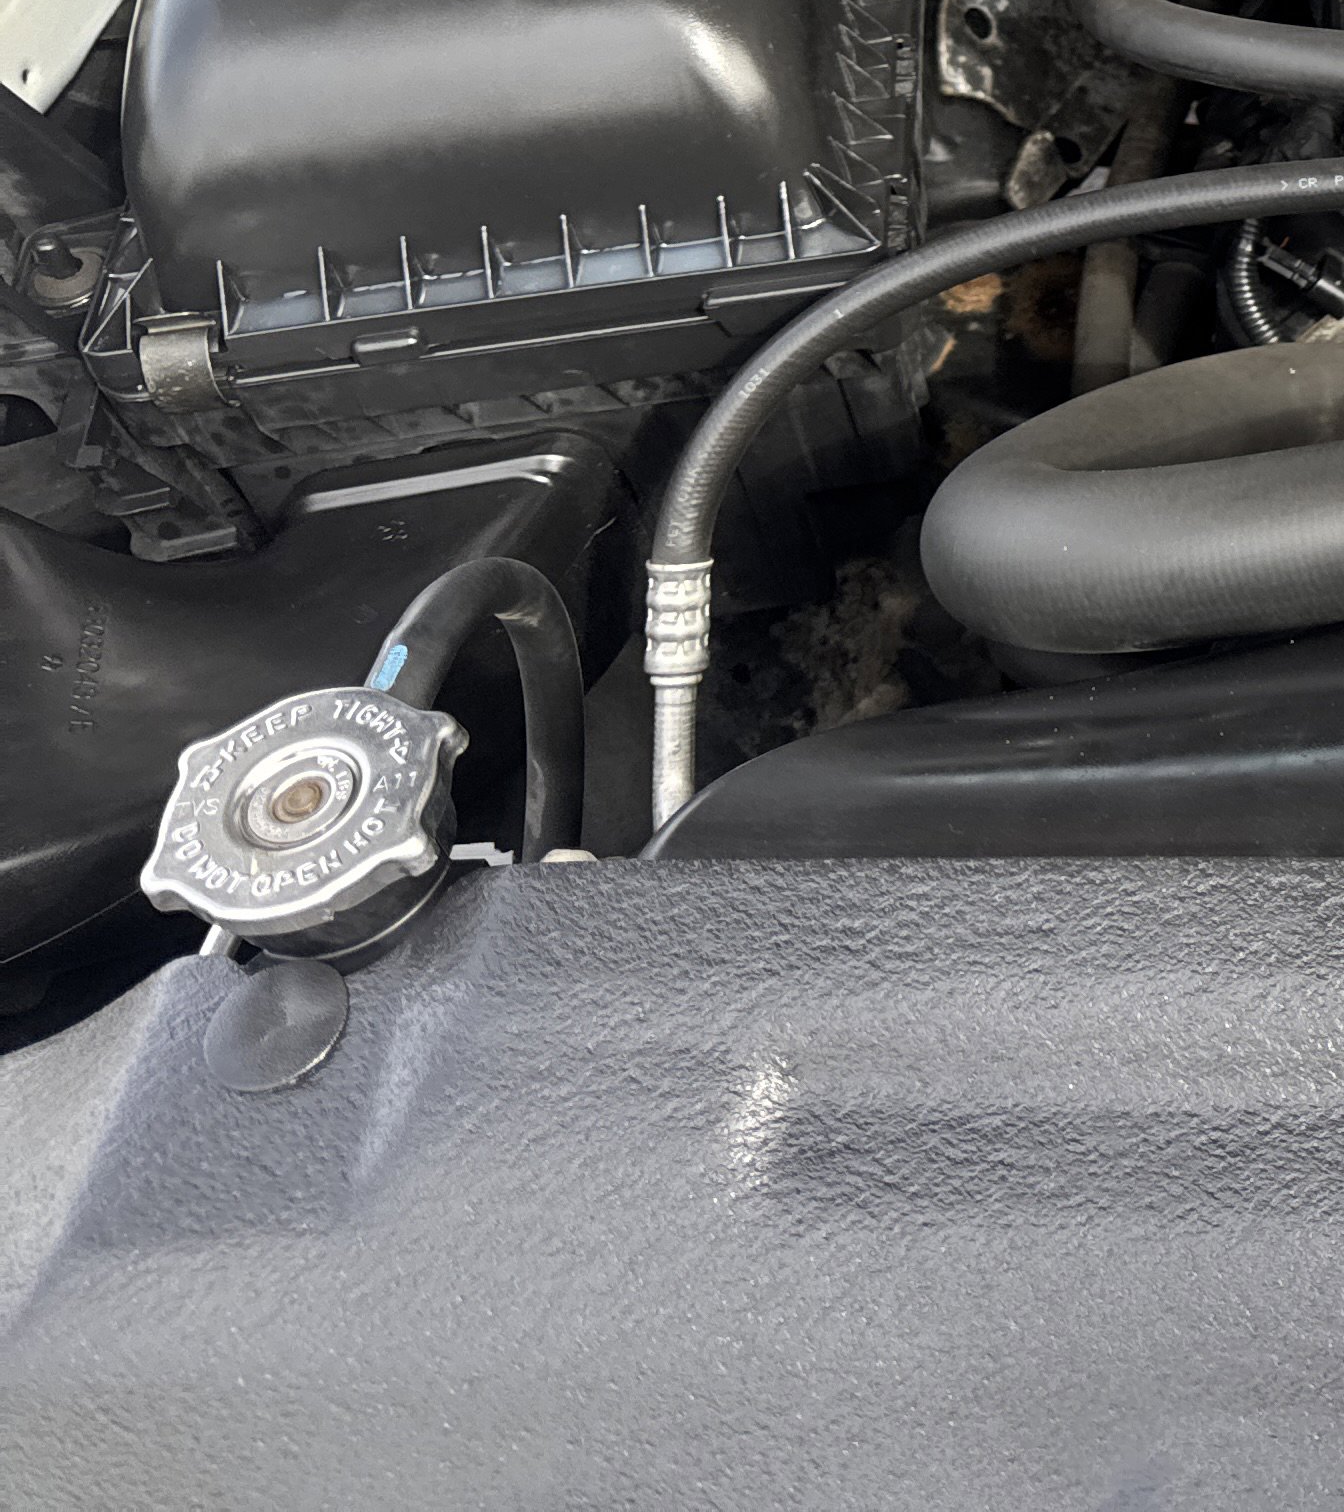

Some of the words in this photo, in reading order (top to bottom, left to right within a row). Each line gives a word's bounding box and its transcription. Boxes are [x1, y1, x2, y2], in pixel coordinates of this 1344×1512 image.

[1299, 177, 1318, 189] CR
[219, 703, 313, 763] KEEP
[175, 797, 221, 818] TVS
[171, 821, 202, 862] DO
[188, 852, 249, 895] NOT
[250, 854, 343, 897] OPEN
[344, 798, 399, 855] HOT
